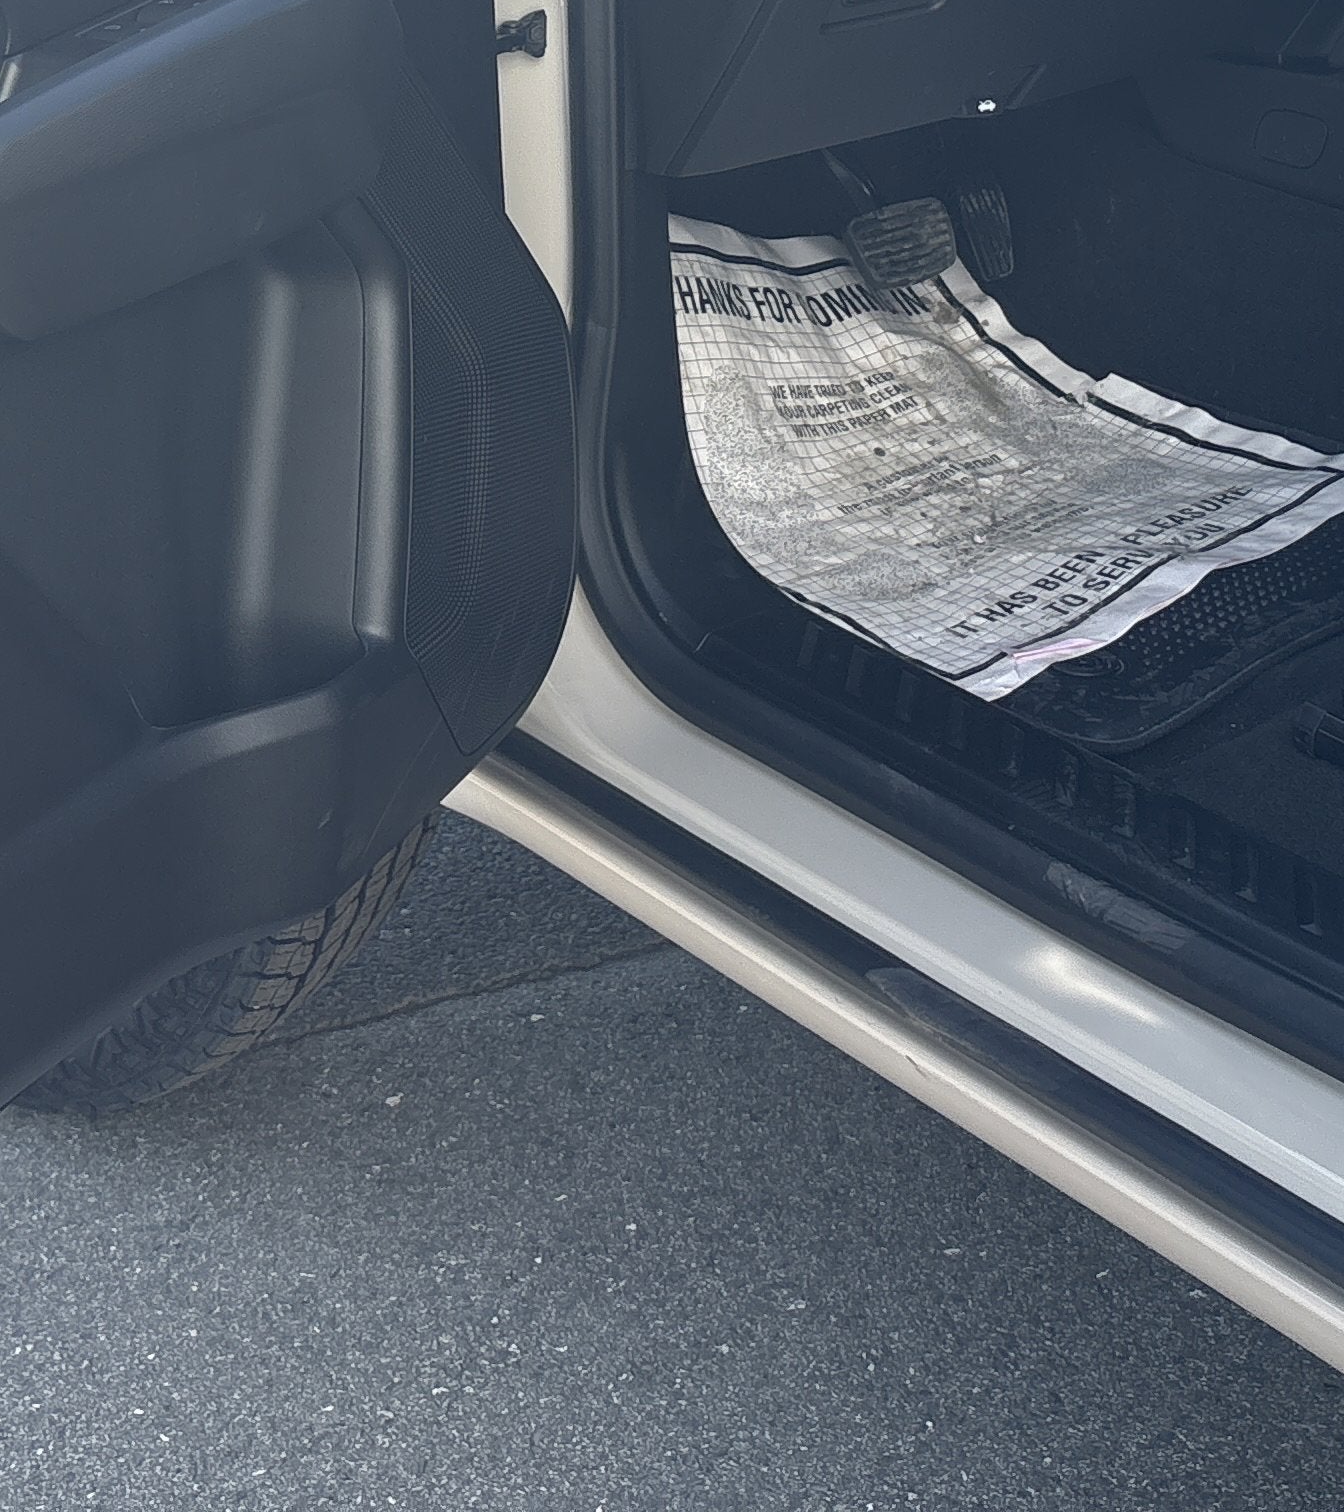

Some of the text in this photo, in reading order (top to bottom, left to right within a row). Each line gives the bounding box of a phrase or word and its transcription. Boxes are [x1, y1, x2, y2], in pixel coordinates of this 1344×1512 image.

[675, 276, 751, 320] HANKS
[747, 287, 801, 324] FOR
[890, 286, 932, 317] IN
[769, 385, 788, 399] WE
[788, 384, 815, 399] HAVE
[813, 383, 846, 397] TRIED
[864, 371, 896, 388] KEEP
[775, 383, 913, 419] YOUR CARPETING CLEAN
[792, 395, 919, 438] WITH THIS PAPER MAT
[838, 501, 863, 516] the
[962, 452, 1001, 471] erson
[946, 619, 978, 639] IT
[975, 590, 1039, 624] HAS
[1031, 549, 1107, 592] BEEN
[1120, 485, 1254, 546] PLEASURE
[1041, 522, 1226, 619] TO SERV YOU
